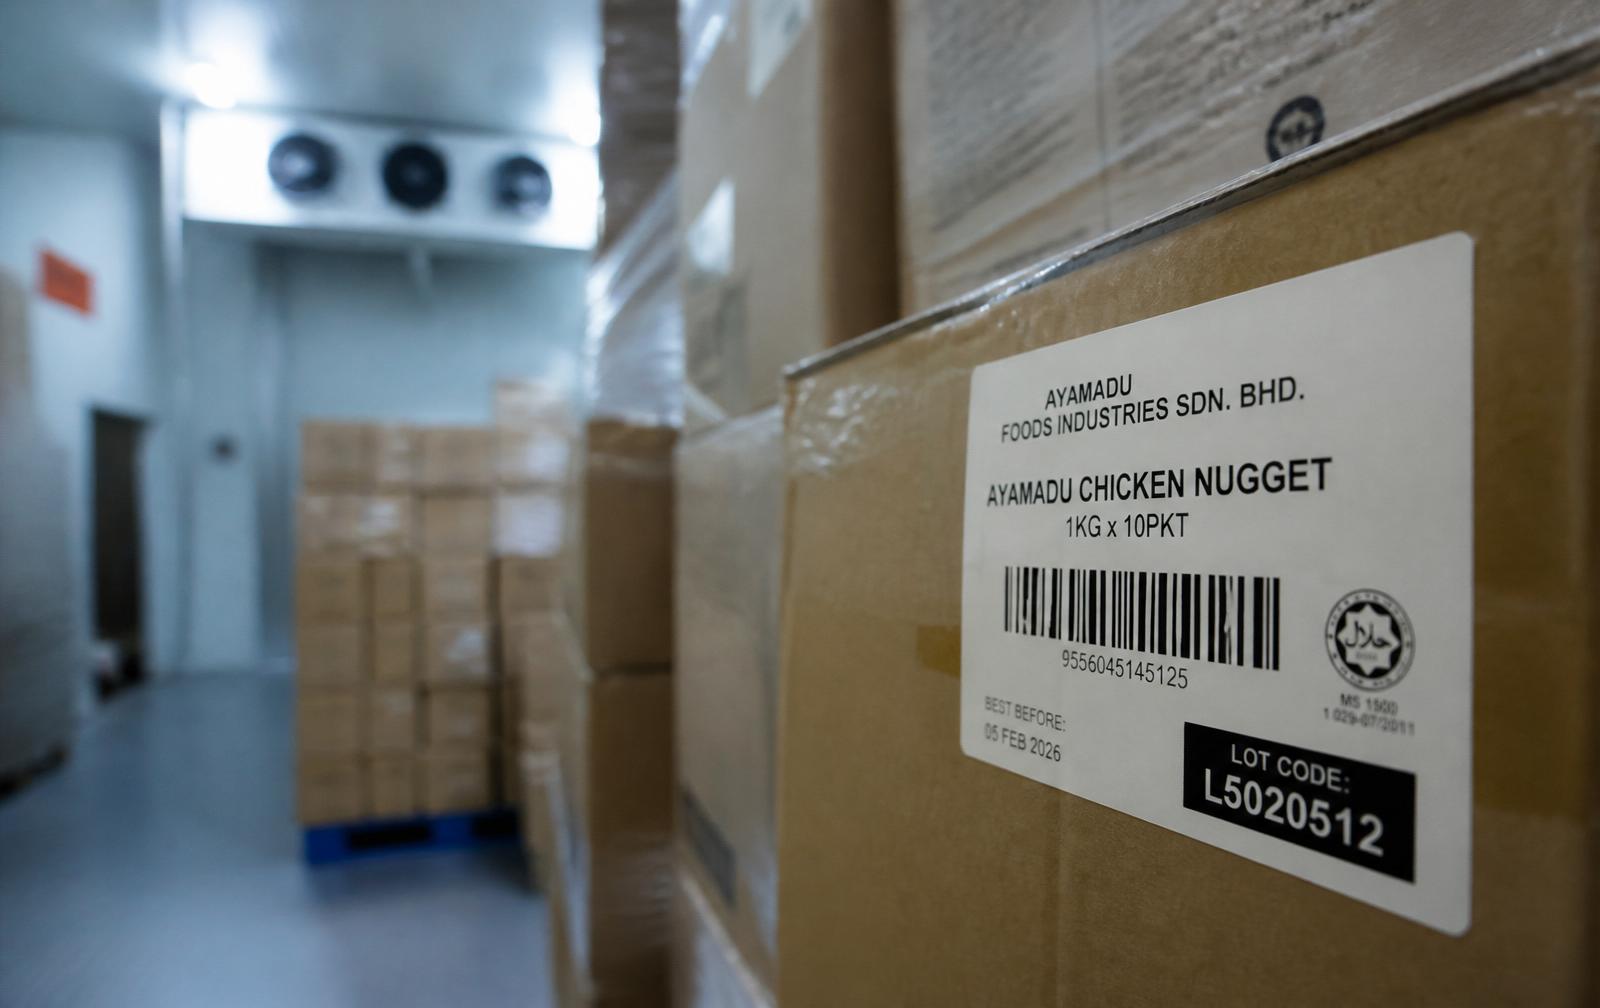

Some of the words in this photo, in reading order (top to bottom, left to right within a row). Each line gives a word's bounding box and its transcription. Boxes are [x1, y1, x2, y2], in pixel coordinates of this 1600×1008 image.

[1001, 417, 1052, 443] FOODS
[1057, 397, 1168, 435] INDUSTRIES
[1175, 387, 1231, 417] SDN.
[1240, 376, 1304, 408] BHD.
[1045, 374, 1132, 410] AYAMADU
[987, 478, 1072, 507] AYAMADU
[1079, 469, 1184, 503] CHICKEN
[1195, 457, 1332, 496] NUGGET
[1065, 515, 1101, 538] 1KG
[1107, 520, 1117, 537] x
[1124, 512, 1189, 538] 10PKT
[1062, 649, 1188, 689] 9556045145125
[984, 696, 1012, 715] BEST
[1015, 704, 1066, 733] BEFORE:
[1340, 693, 1360, 709] MS
[984, 722, 999, 741] 05
[1002, 728, 1026, 750] FEB
[1030, 736, 1061, 762] 2026
[1232, 744, 1270, 770] LOT
[1277, 756, 1350, 794] CODE:
[1205, 768, 1384, 856] L5020512
